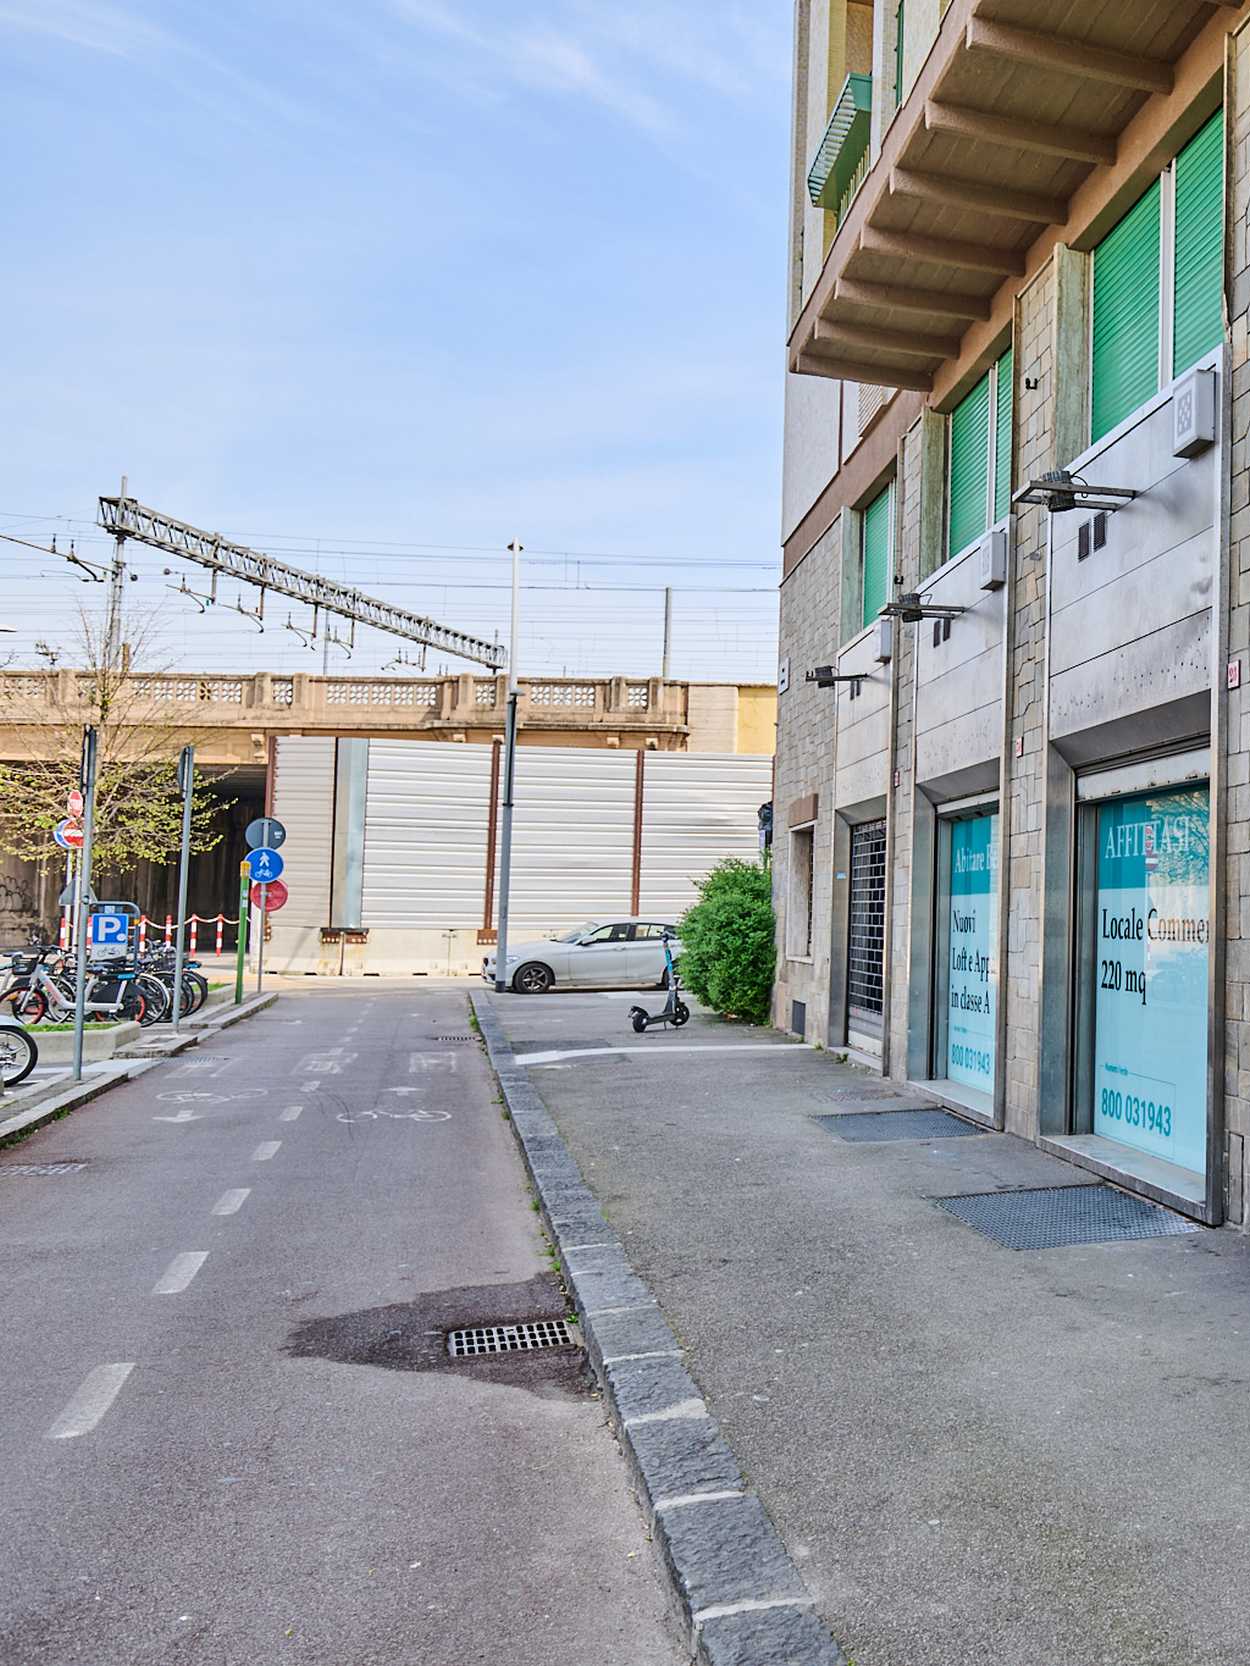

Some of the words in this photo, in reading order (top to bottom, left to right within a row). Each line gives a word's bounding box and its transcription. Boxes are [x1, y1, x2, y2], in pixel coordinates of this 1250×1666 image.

[1105, 816, 1190, 859] AFFITTASI
[955, 847, 985, 872] Abitare
[98, 916, 121, 942] P
[953, 909, 976, 933] Nuovi
[1102, 907, 1143, 940] Locale
[952, 946, 967, 971] Loft
[968, 956, 973, 972] e
[1101, 960, 1121, 991] 220
[1125, 969, 1147, 1006] mq
[951, 984, 959, 1008] in
[960, 985, 982, 1013] classe
[983, 990, 990, 1014] A
[951, 1043, 963, 1067] 800
[1102, 1087, 1122, 1120] 800
[1125, 1095, 1171, 1137] 031943
